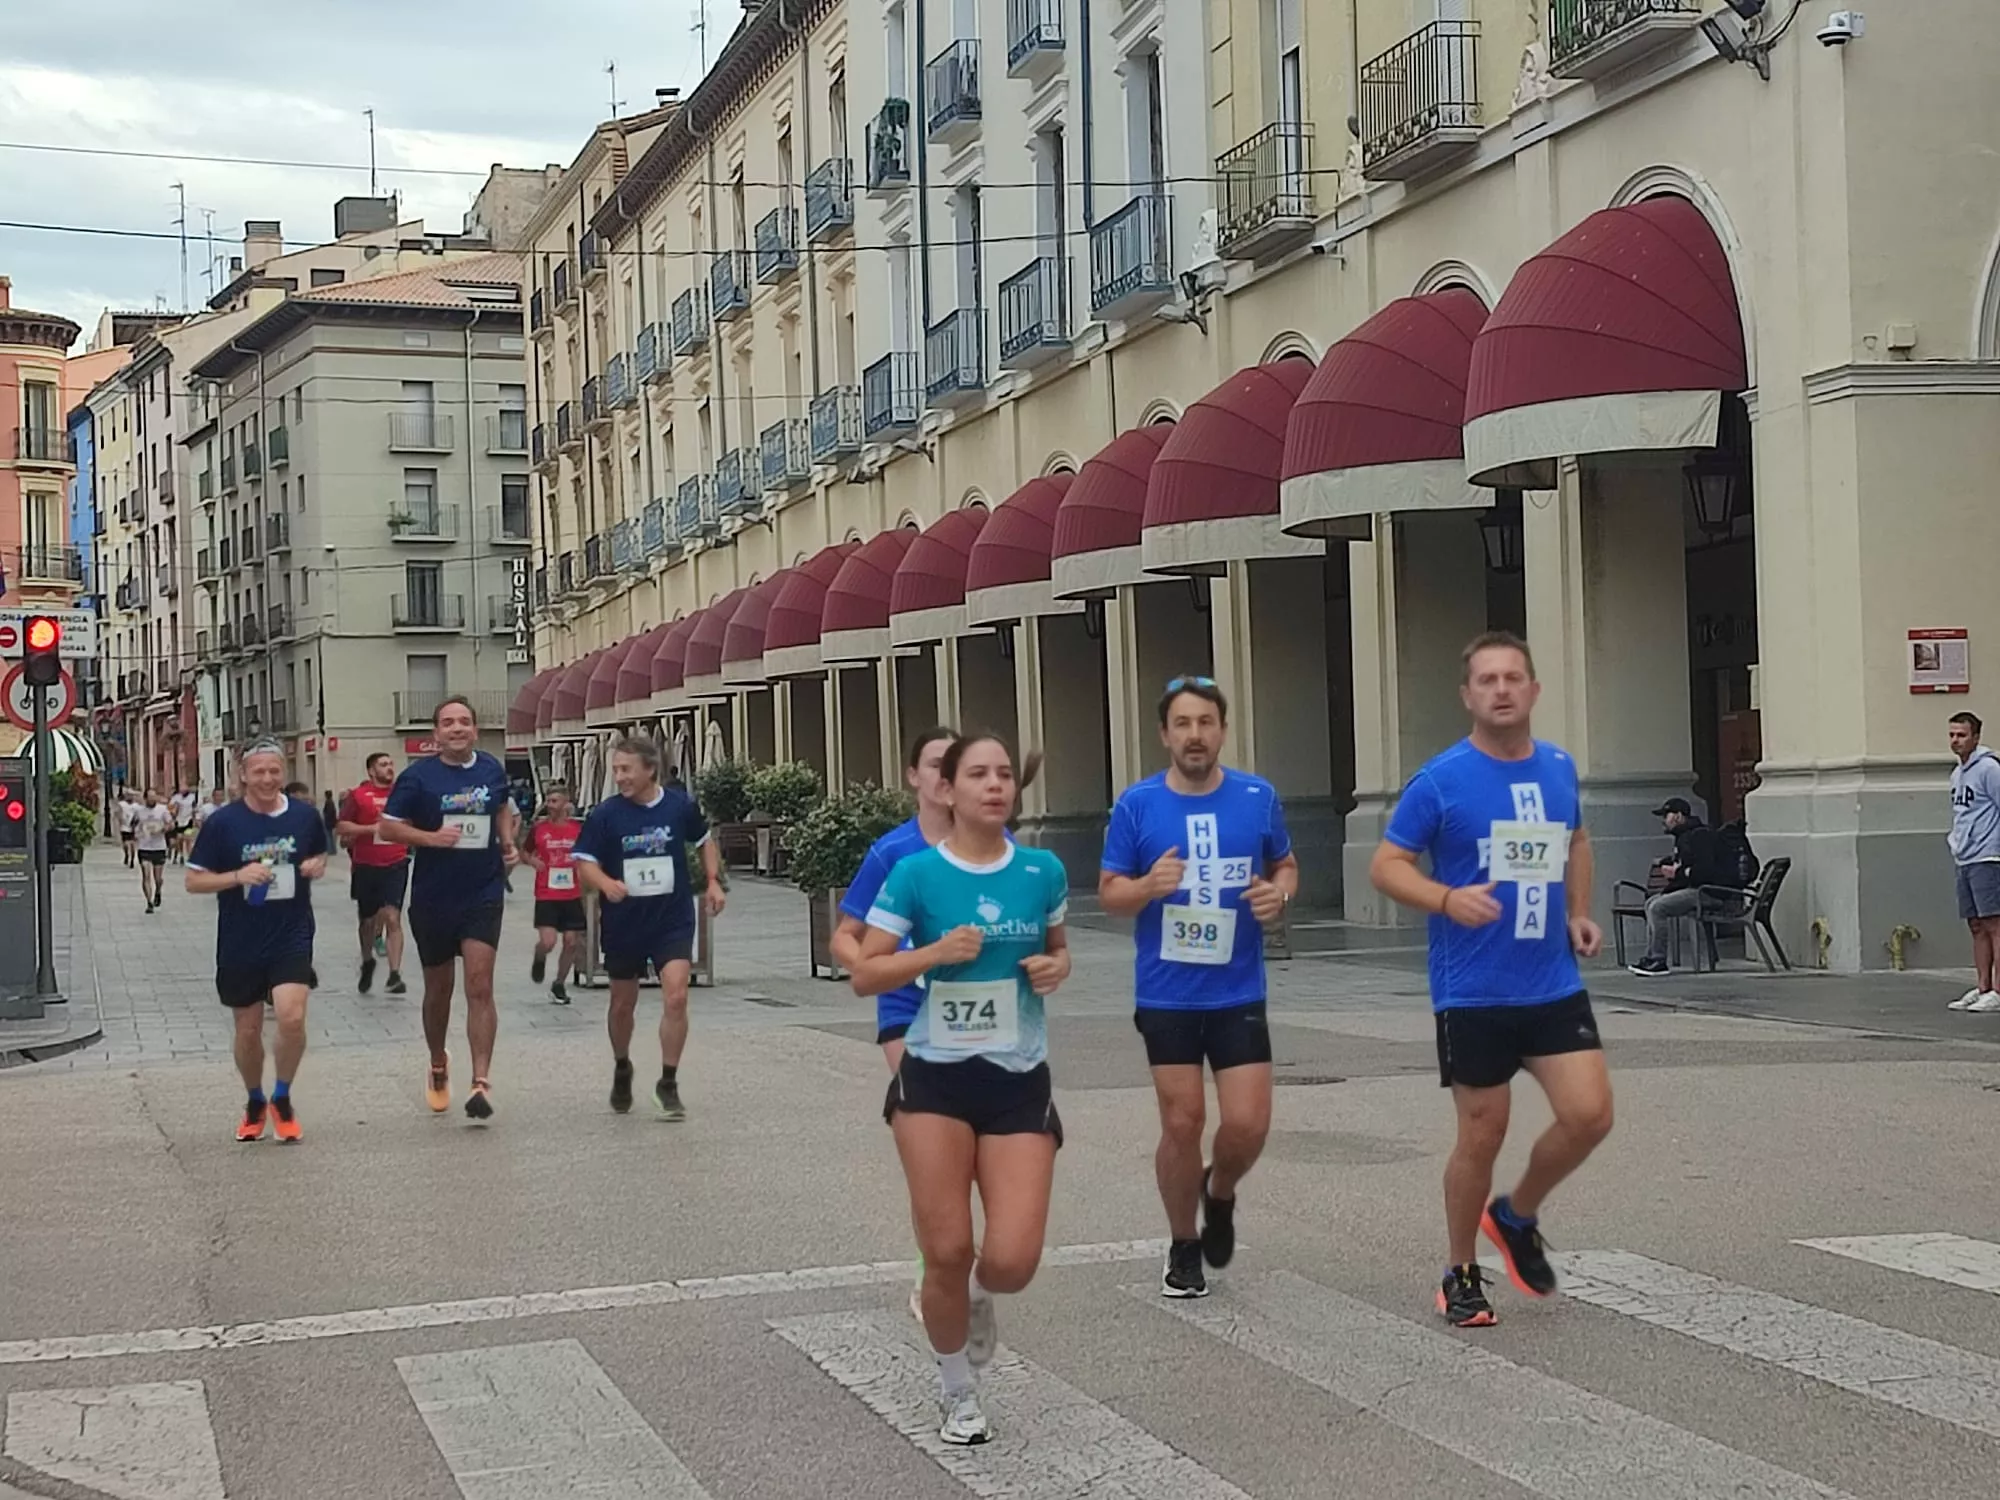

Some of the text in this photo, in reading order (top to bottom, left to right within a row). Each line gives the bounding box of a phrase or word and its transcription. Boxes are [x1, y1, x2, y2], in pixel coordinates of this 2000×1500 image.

[513, 558, 526, 646] HOSTAL
[1504, 841, 1549, 861] 397
[1194, 820, 1212, 905] HUES
[1223, 863, 1247, 881] 25
[637, 869, 656, 881] 11
[1173, 921, 1218, 942] 398
[942, 999, 997, 1023] 374
